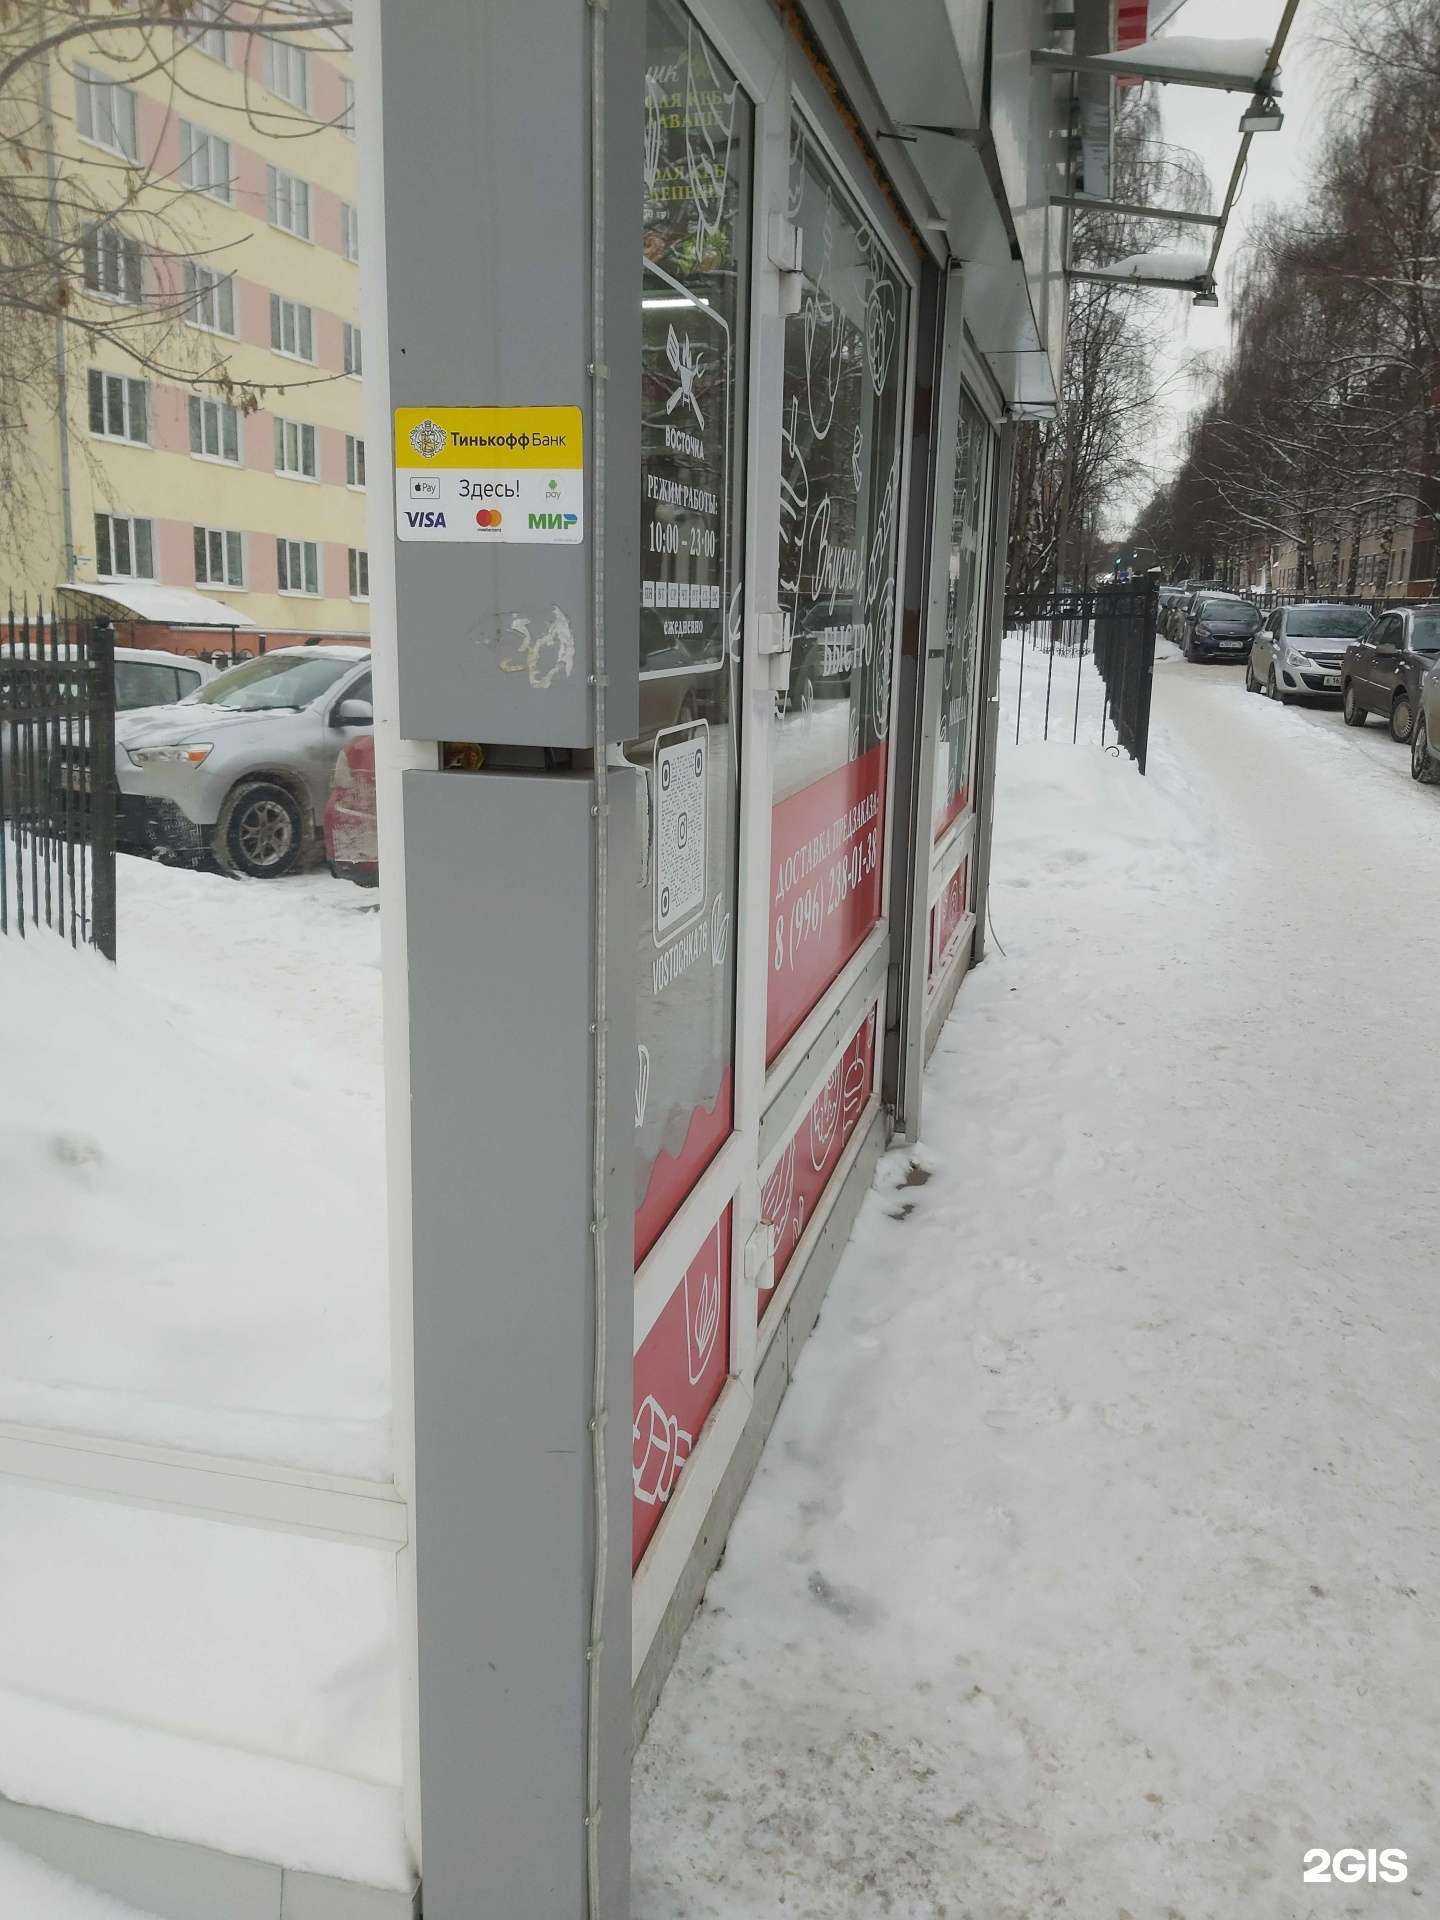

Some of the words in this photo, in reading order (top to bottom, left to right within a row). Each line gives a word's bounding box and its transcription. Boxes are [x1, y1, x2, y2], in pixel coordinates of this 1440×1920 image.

[451, 432, 529, 449] Тинькофф
[532, 433, 566, 447] Банк
[665, 425, 705, 460] ВОСТОЧКА
[422, 483, 436, 494] Pay
[458, 479, 520, 500] Здесь!
[647, 474, 682, 506] РЕЖИМ
[682, 486, 718, 515] РАБОТЫ:
[404, 511, 447, 528] VISA
[528, 513, 577, 529] МИР
[649, 520, 679, 554] 10:00
[775, 828, 831, 906] ДОСТАВКА
[774, 914, 785, 971] 8
[789, 879, 824, 972] (996)
[826, 827, 878, 915] 238-01-38
